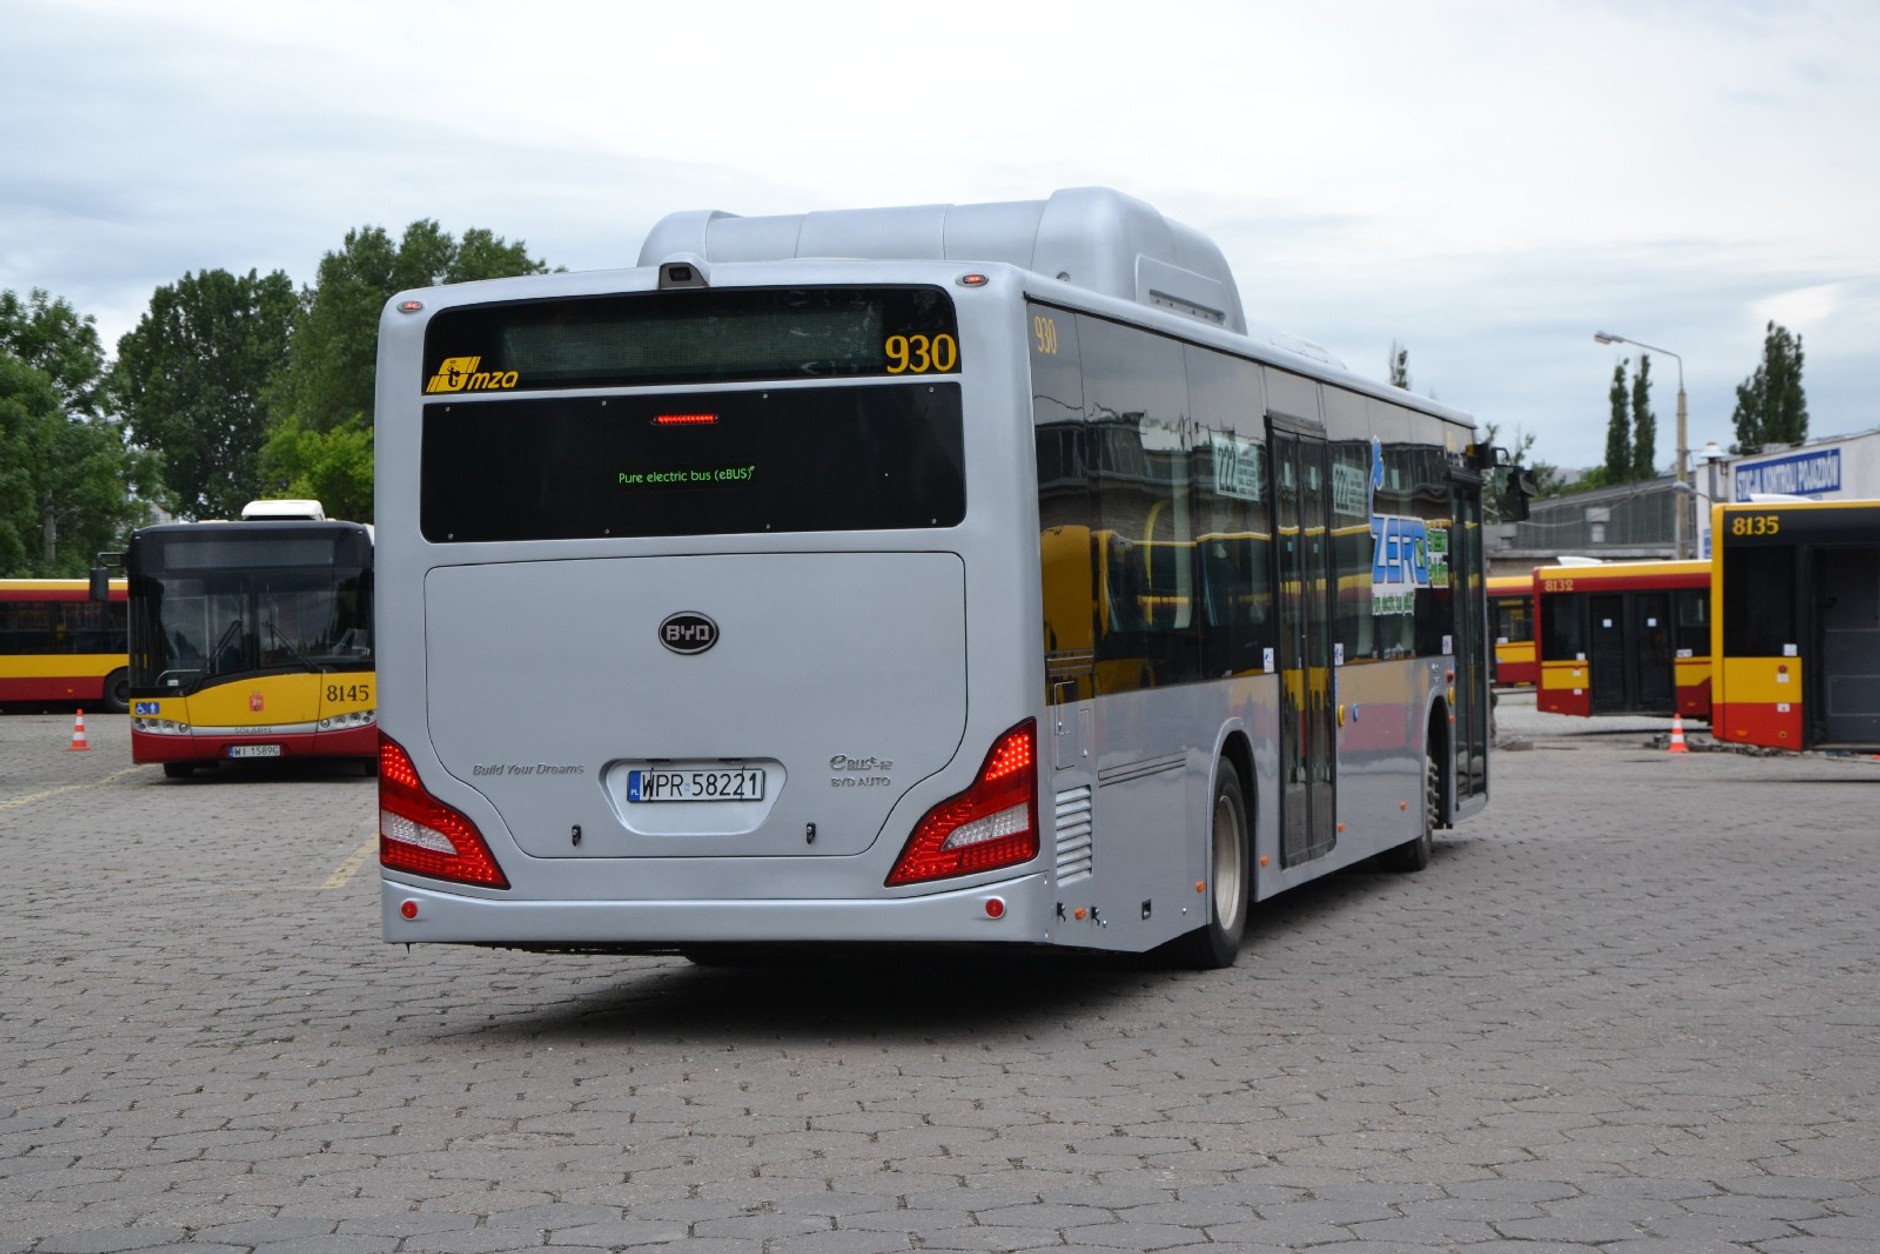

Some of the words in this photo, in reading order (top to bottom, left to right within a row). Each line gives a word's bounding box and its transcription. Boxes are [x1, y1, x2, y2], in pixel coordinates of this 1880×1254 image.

[1035, 316, 1057, 355] 930
[885, 333, 957, 374] 930
[467, 370, 519, 390] mza
[619, 472, 643, 484] Pure
[646, 470, 688, 483] electric
[690, 470, 711, 481] bus
[714, 467, 752, 481] (eBUS)
[1732, 515, 1780, 535] 8135
[1370, 516, 1428, 586] ZERO
[1545, 579, 1574, 592] 8132
[666, 625, 710, 641] BYD
[326, 684, 370, 703] 8145
[234, 746, 246, 757] WI
[473, 764, 505, 776] Build
[507, 763, 535, 775] Your
[536, 763, 585, 775] Dreams
[642, 773, 684, 797] WPR
[692, 773, 758, 796] 58221
[831, 777, 856, 788] BYD
[858, 776, 891, 787] AUTO
